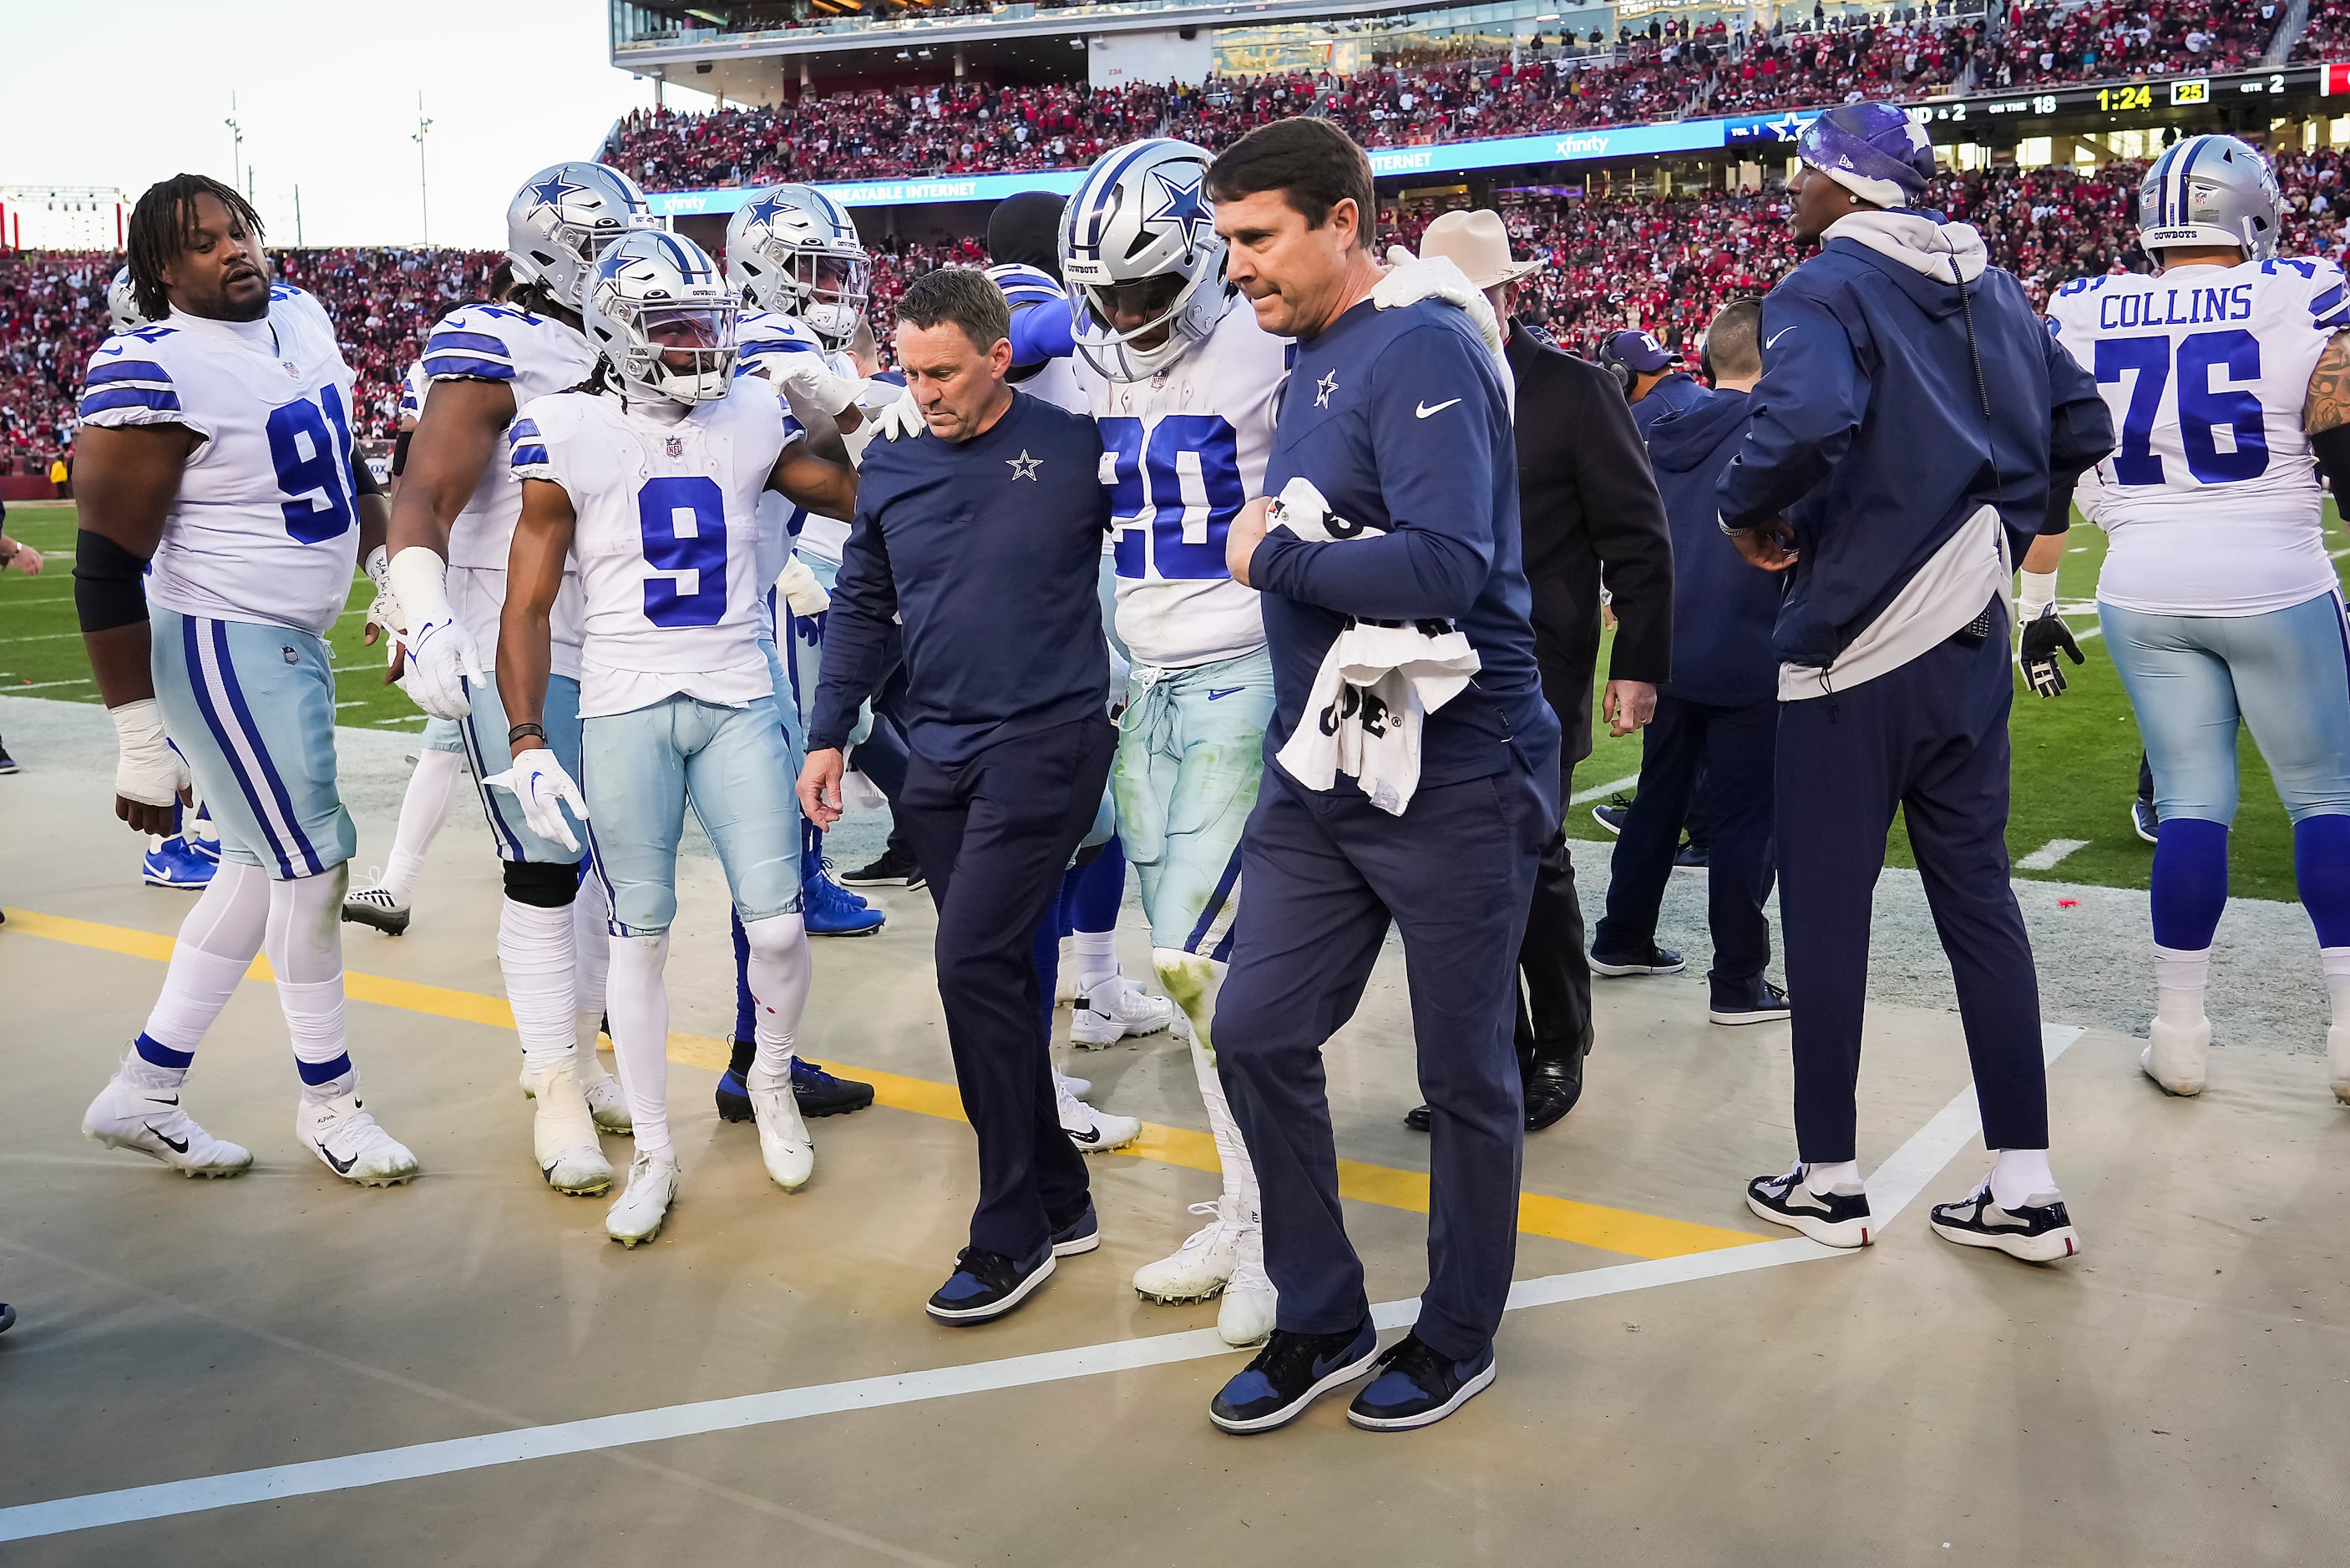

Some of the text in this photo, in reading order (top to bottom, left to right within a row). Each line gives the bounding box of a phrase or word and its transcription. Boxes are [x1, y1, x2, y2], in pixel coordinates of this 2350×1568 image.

[1903, 74, 2285, 124] ND & 2 ON THE 18 1:24 25 QTR 2
[1752, 124, 1760, 135] 1
[1555, 135, 1609, 157] xfinity
[905, 182, 977, 199] INTERNET
[663, 195, 707, 211] xfinity
[2154, 230, 2197, 240] COWBOYS
[1067, 264, 1099, 274] COWBOYS
[2099, 283, 2253, 330] COLLINS
[1639, 334, 1659, 352] D
[2094, 329, 2270, 485] 76
[668, 445, 681, 454] NFL
[265, 382, 361, 545] 91
[1096, 414, 1246, 579] 20
[637, 476, 727, 628] 9
[317, 1115, 337, 1124] ALPHA
